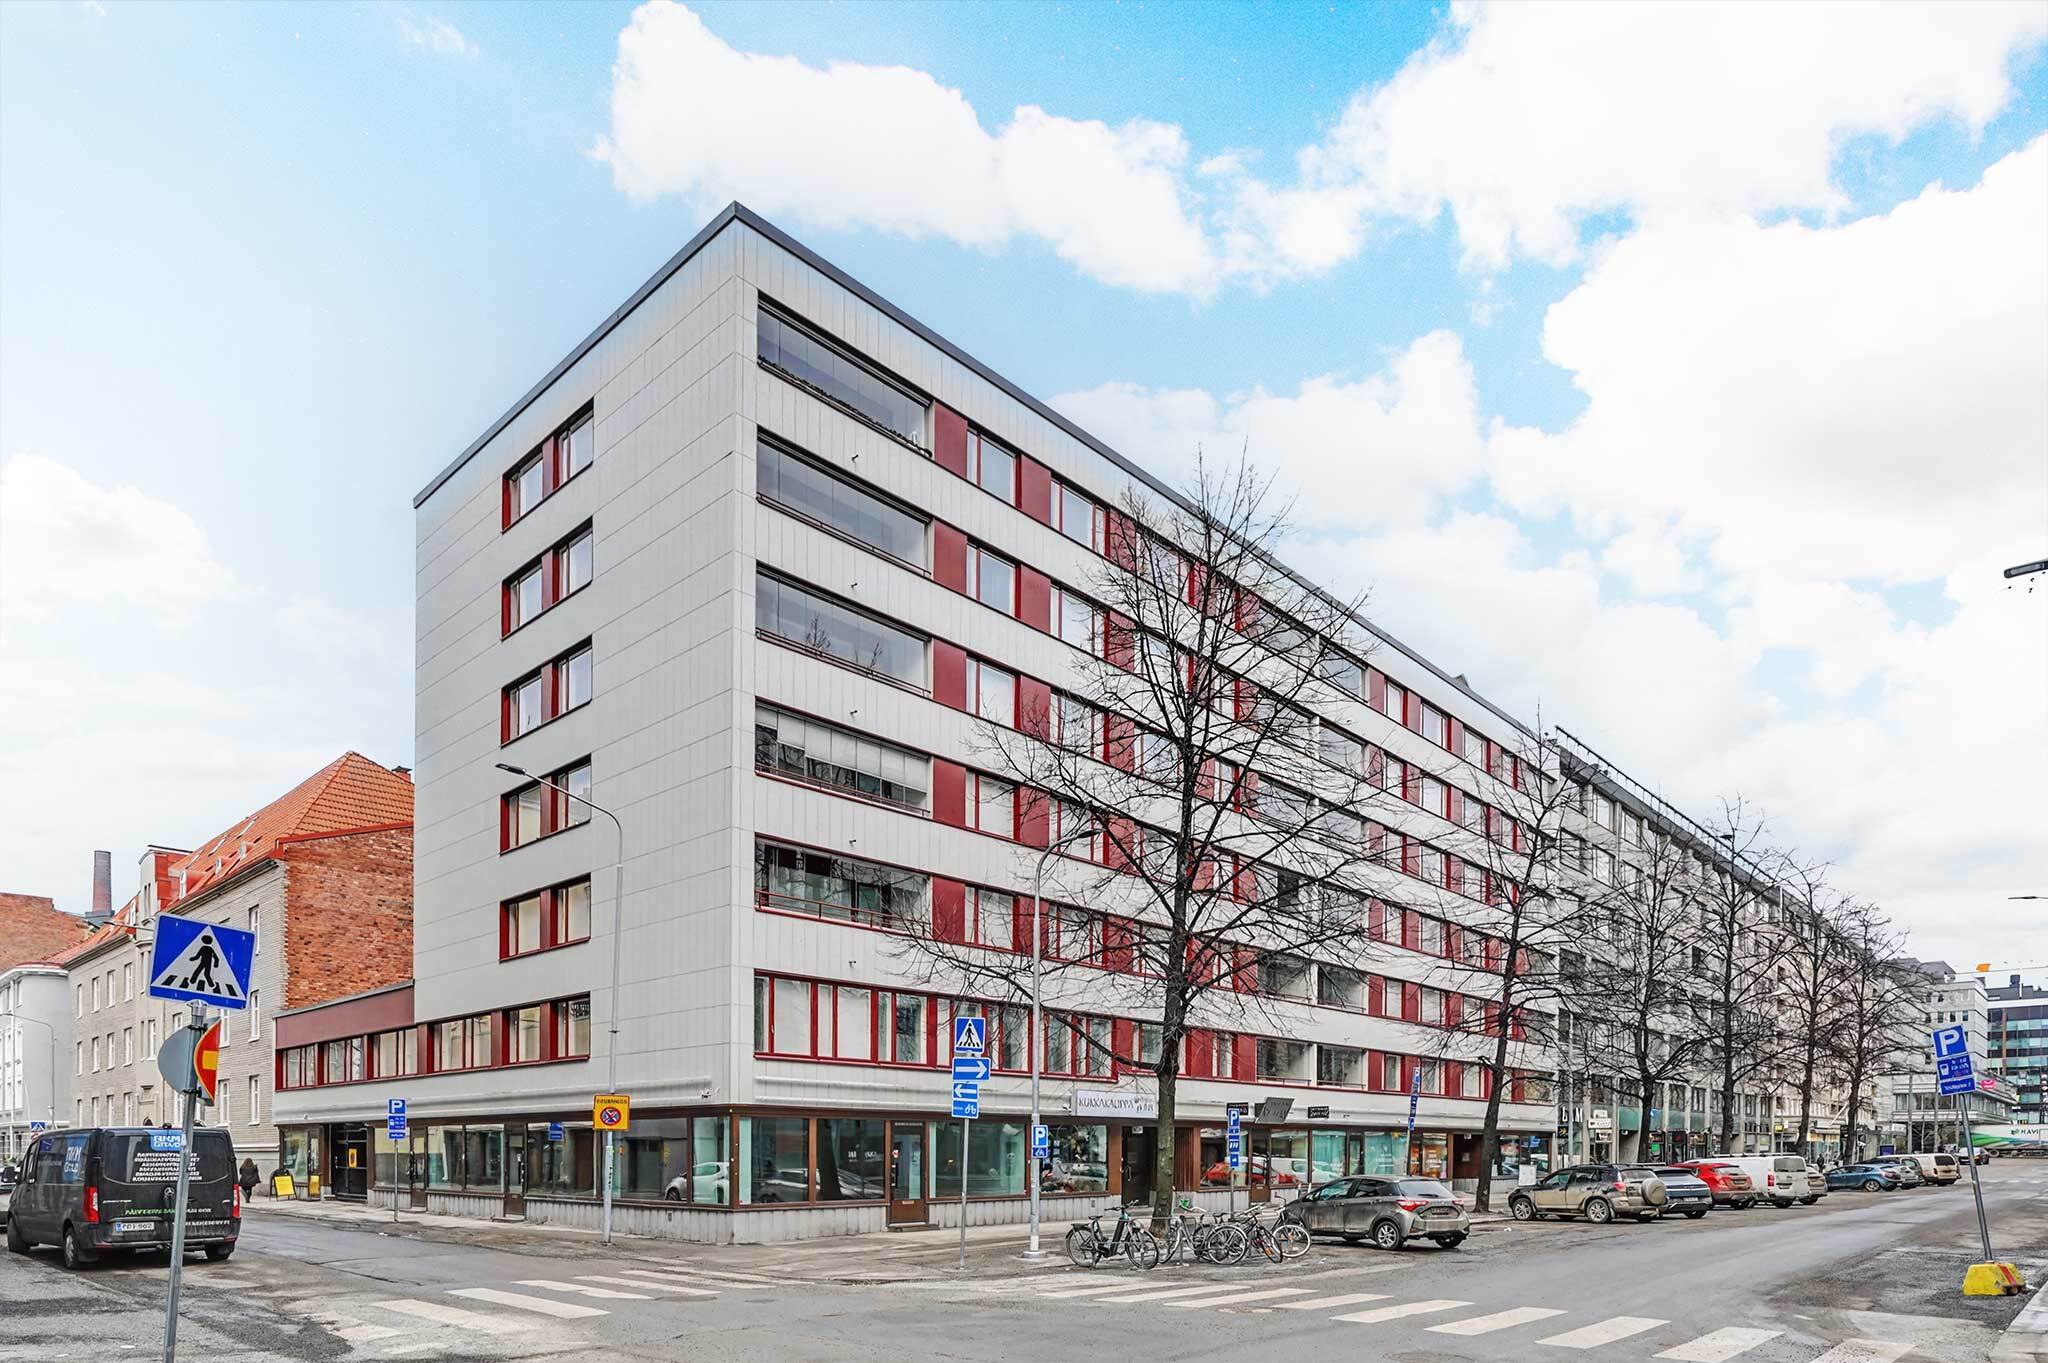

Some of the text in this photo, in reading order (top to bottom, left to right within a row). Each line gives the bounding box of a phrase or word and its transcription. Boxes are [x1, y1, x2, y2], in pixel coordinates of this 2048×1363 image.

[1939, 1029, 1960, 1056] P
[391, 1100, 403, 1114] P
[1230, 1110, 1238, 1125] P
[1035, 1127, 1046, 1146] P
